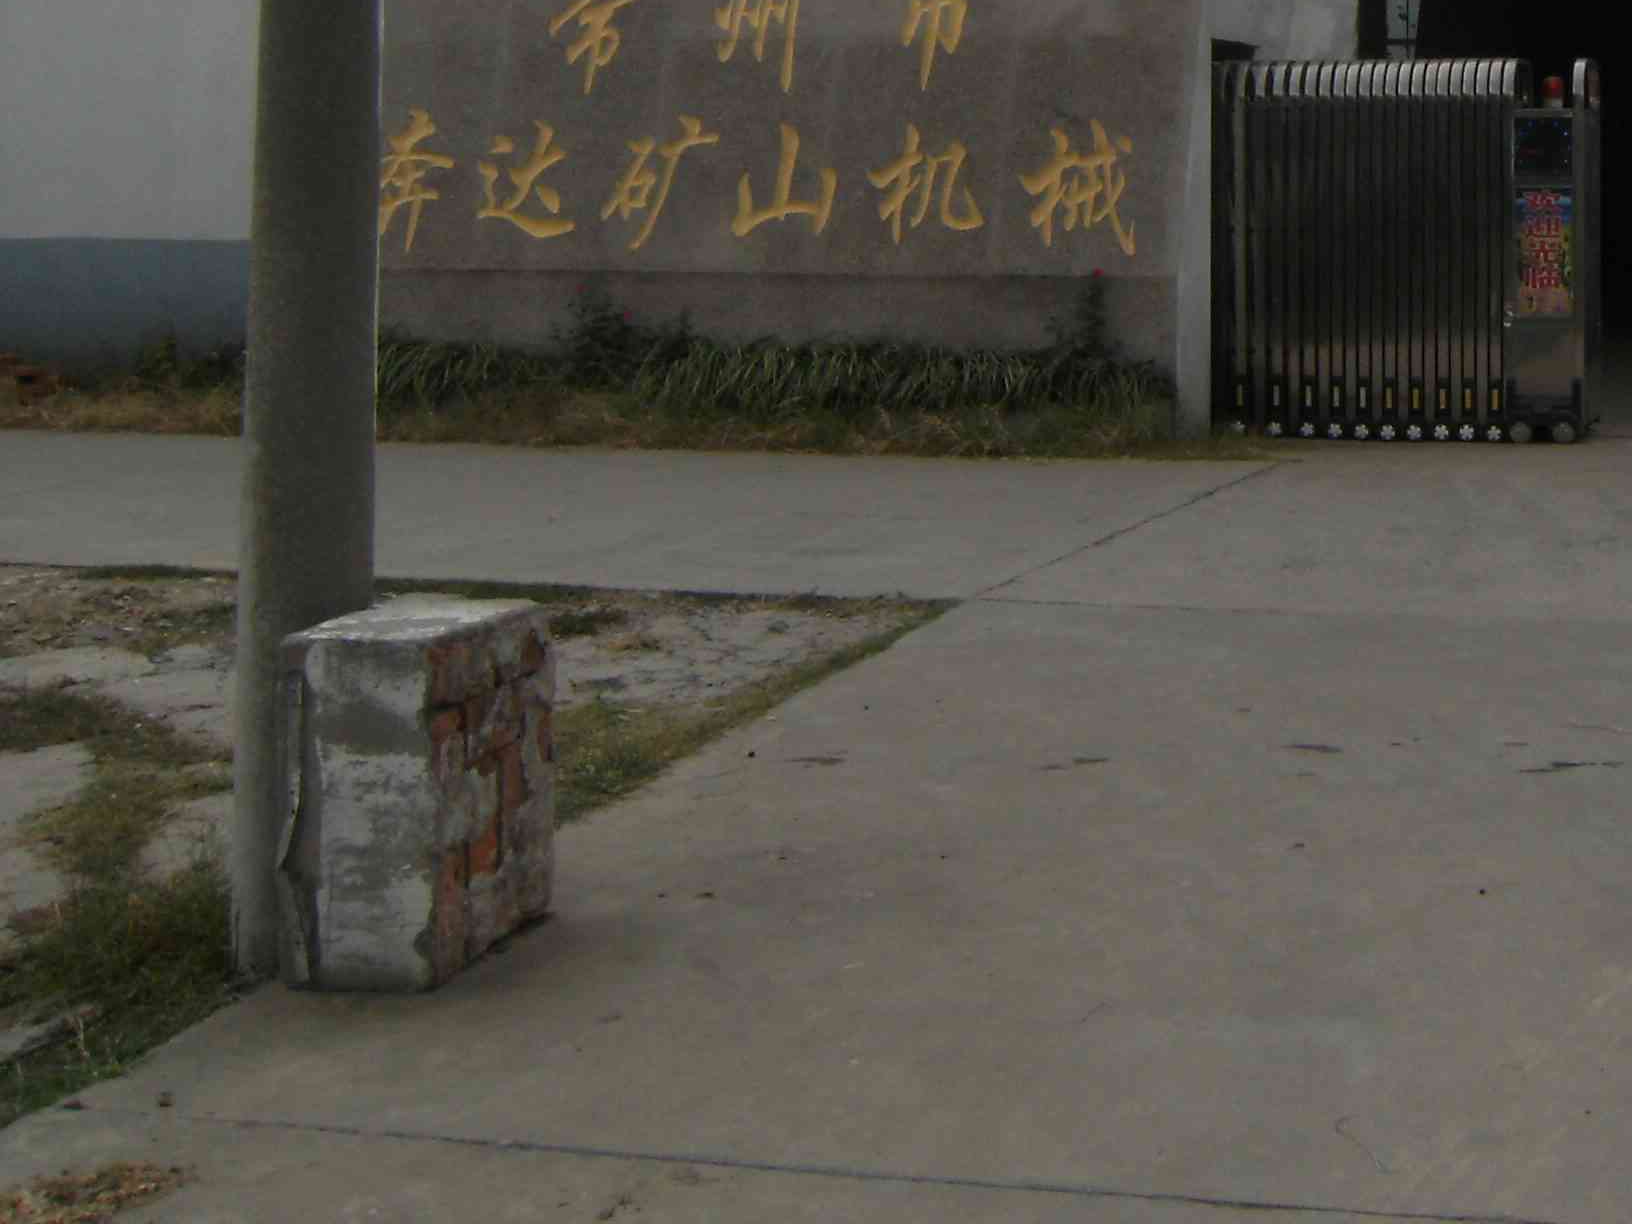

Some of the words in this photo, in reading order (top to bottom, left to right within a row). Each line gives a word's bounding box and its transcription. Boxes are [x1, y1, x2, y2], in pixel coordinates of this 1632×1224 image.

[380, 109, 1137, 255] 奔达矿山机械
